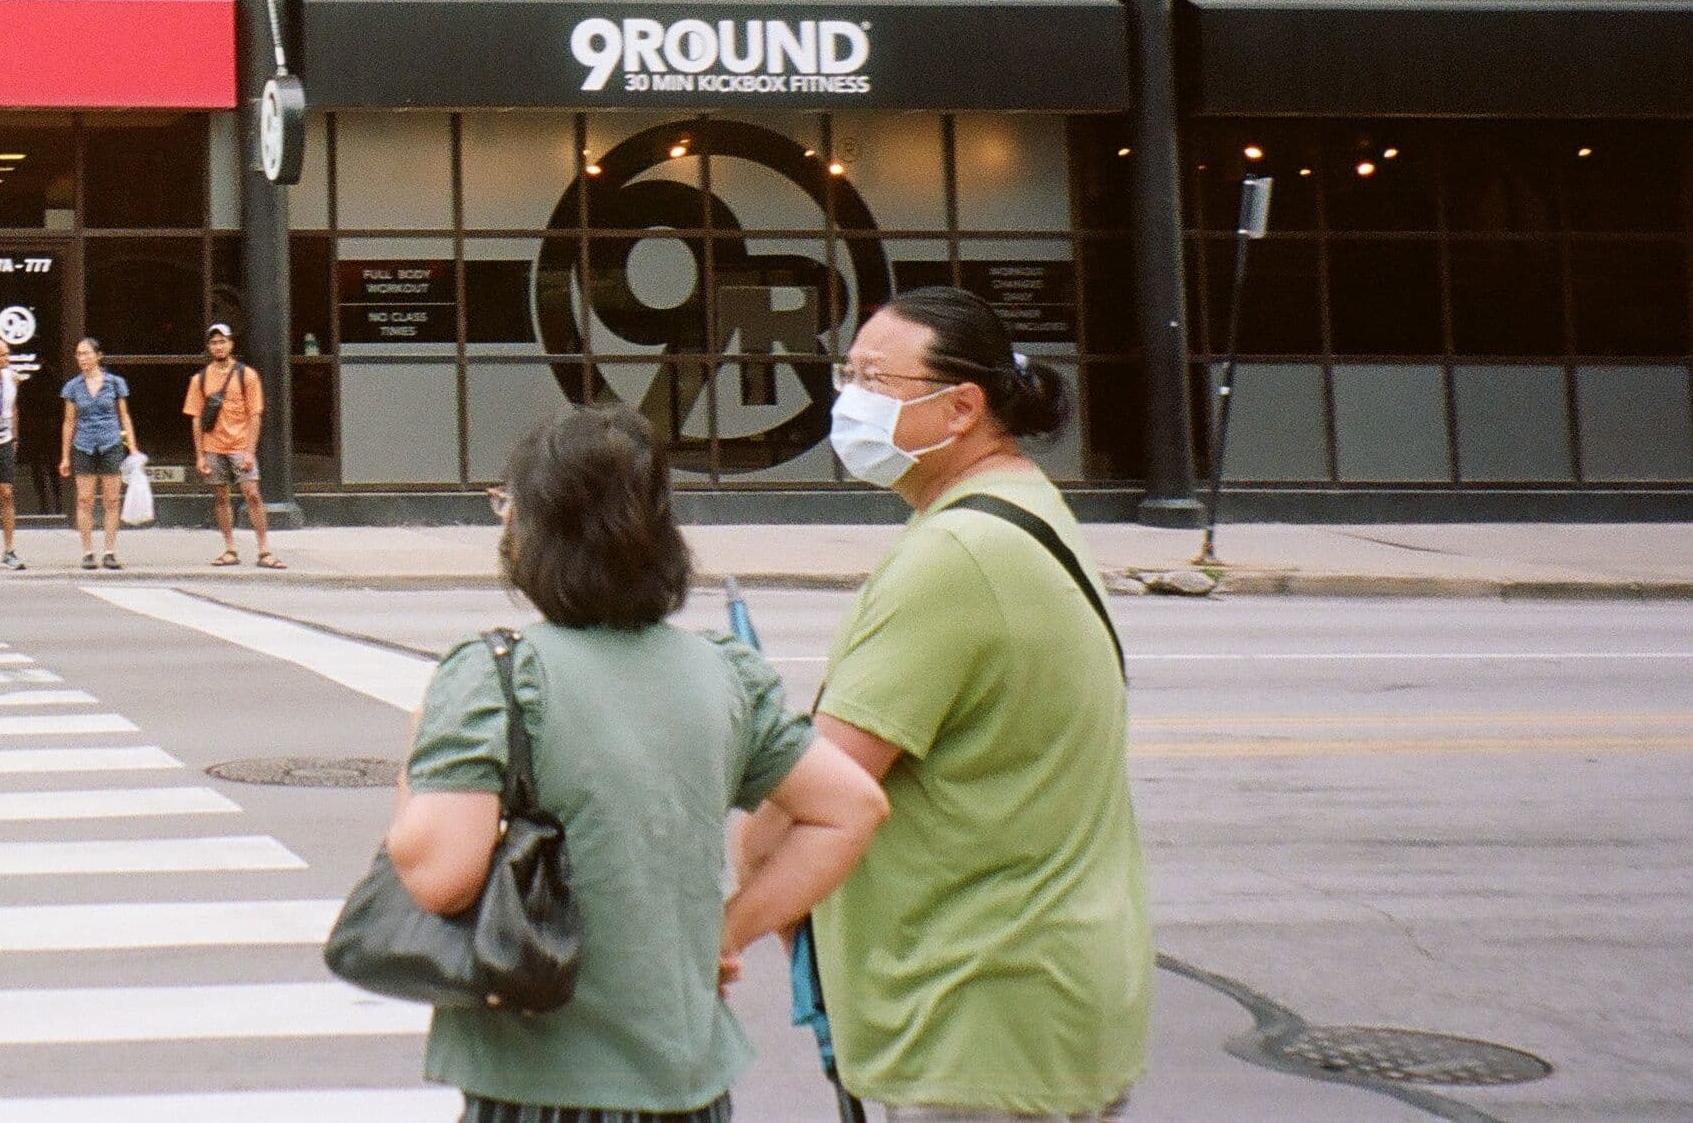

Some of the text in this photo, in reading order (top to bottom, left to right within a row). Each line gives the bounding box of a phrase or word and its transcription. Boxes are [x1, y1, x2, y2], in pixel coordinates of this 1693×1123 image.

[570, 17, 871, 92] 9ROUND
[623, 74, 871, 93] 30 MIN KICKBOX FITNESS
[362, 268, 432, 279] FULL BODY
[366, 283, 430, 294] WORKOUT
[368, 312, 428, 322] NO CLASS
[379, 326, 418, 336] TIMES
[143, 468, 174, 480] PEN
